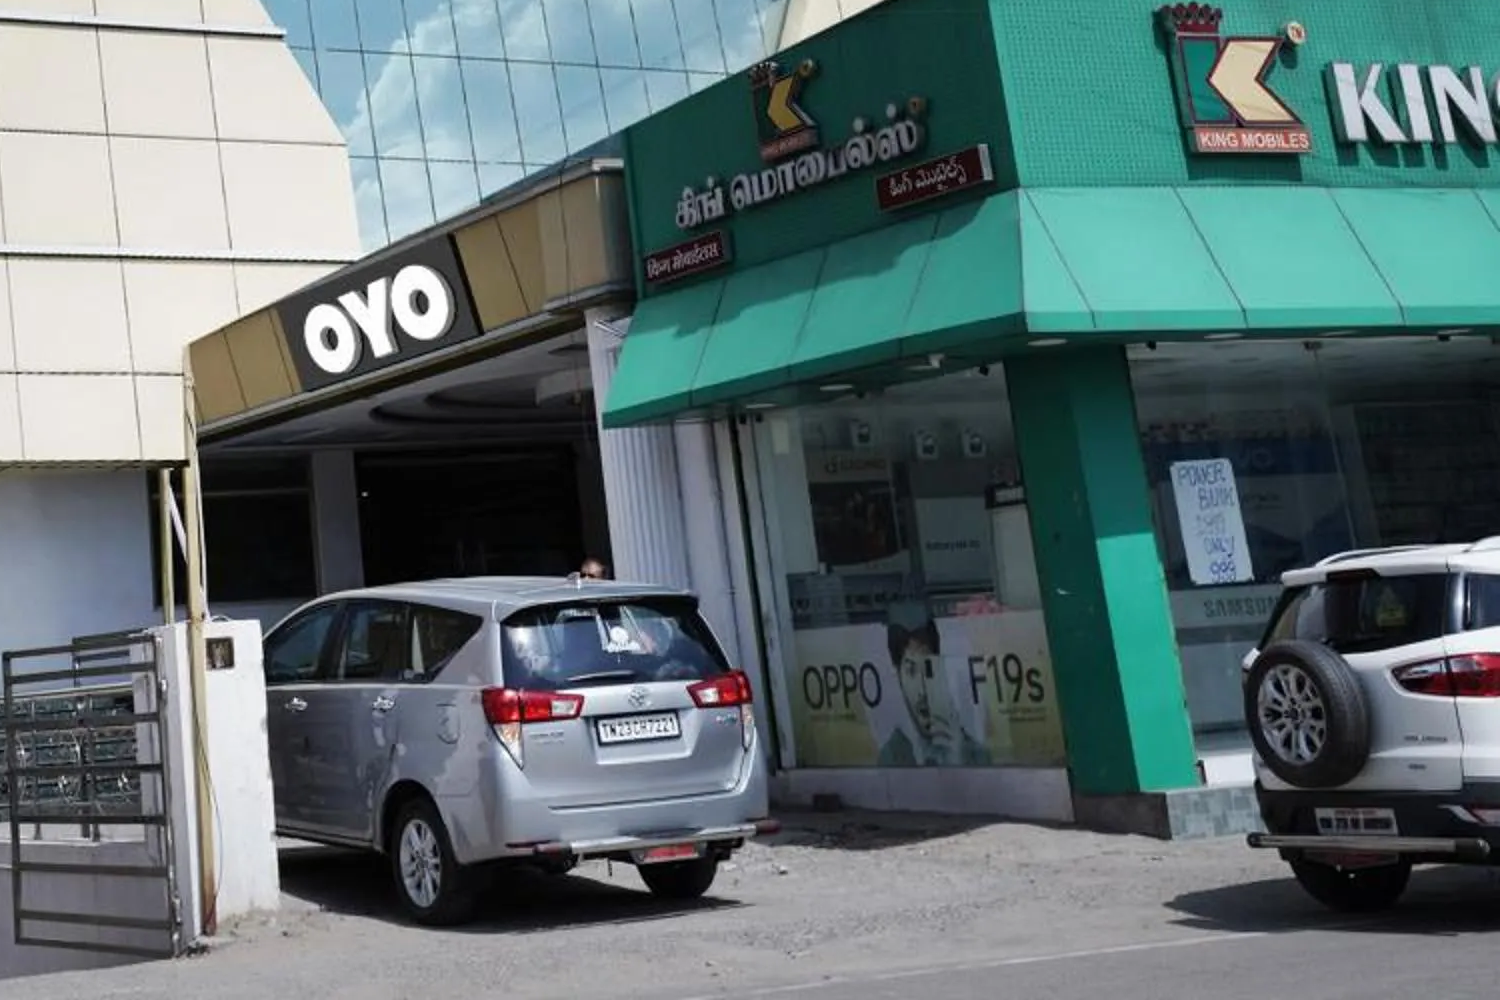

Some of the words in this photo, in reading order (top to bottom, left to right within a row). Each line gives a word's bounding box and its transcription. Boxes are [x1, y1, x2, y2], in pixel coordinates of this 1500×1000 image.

[1330, 61, 1500, 143] KIN
[1199, 131, 1238, 148] KING
[1241, 132, 1310, 149] MOBILES
[303, 264, 456, 375] OYO
[1203, 597, 1279, 619] SAMSU
[802, 661, 883, 710] OPPO
[967, 652, 1046, 705] F19s
